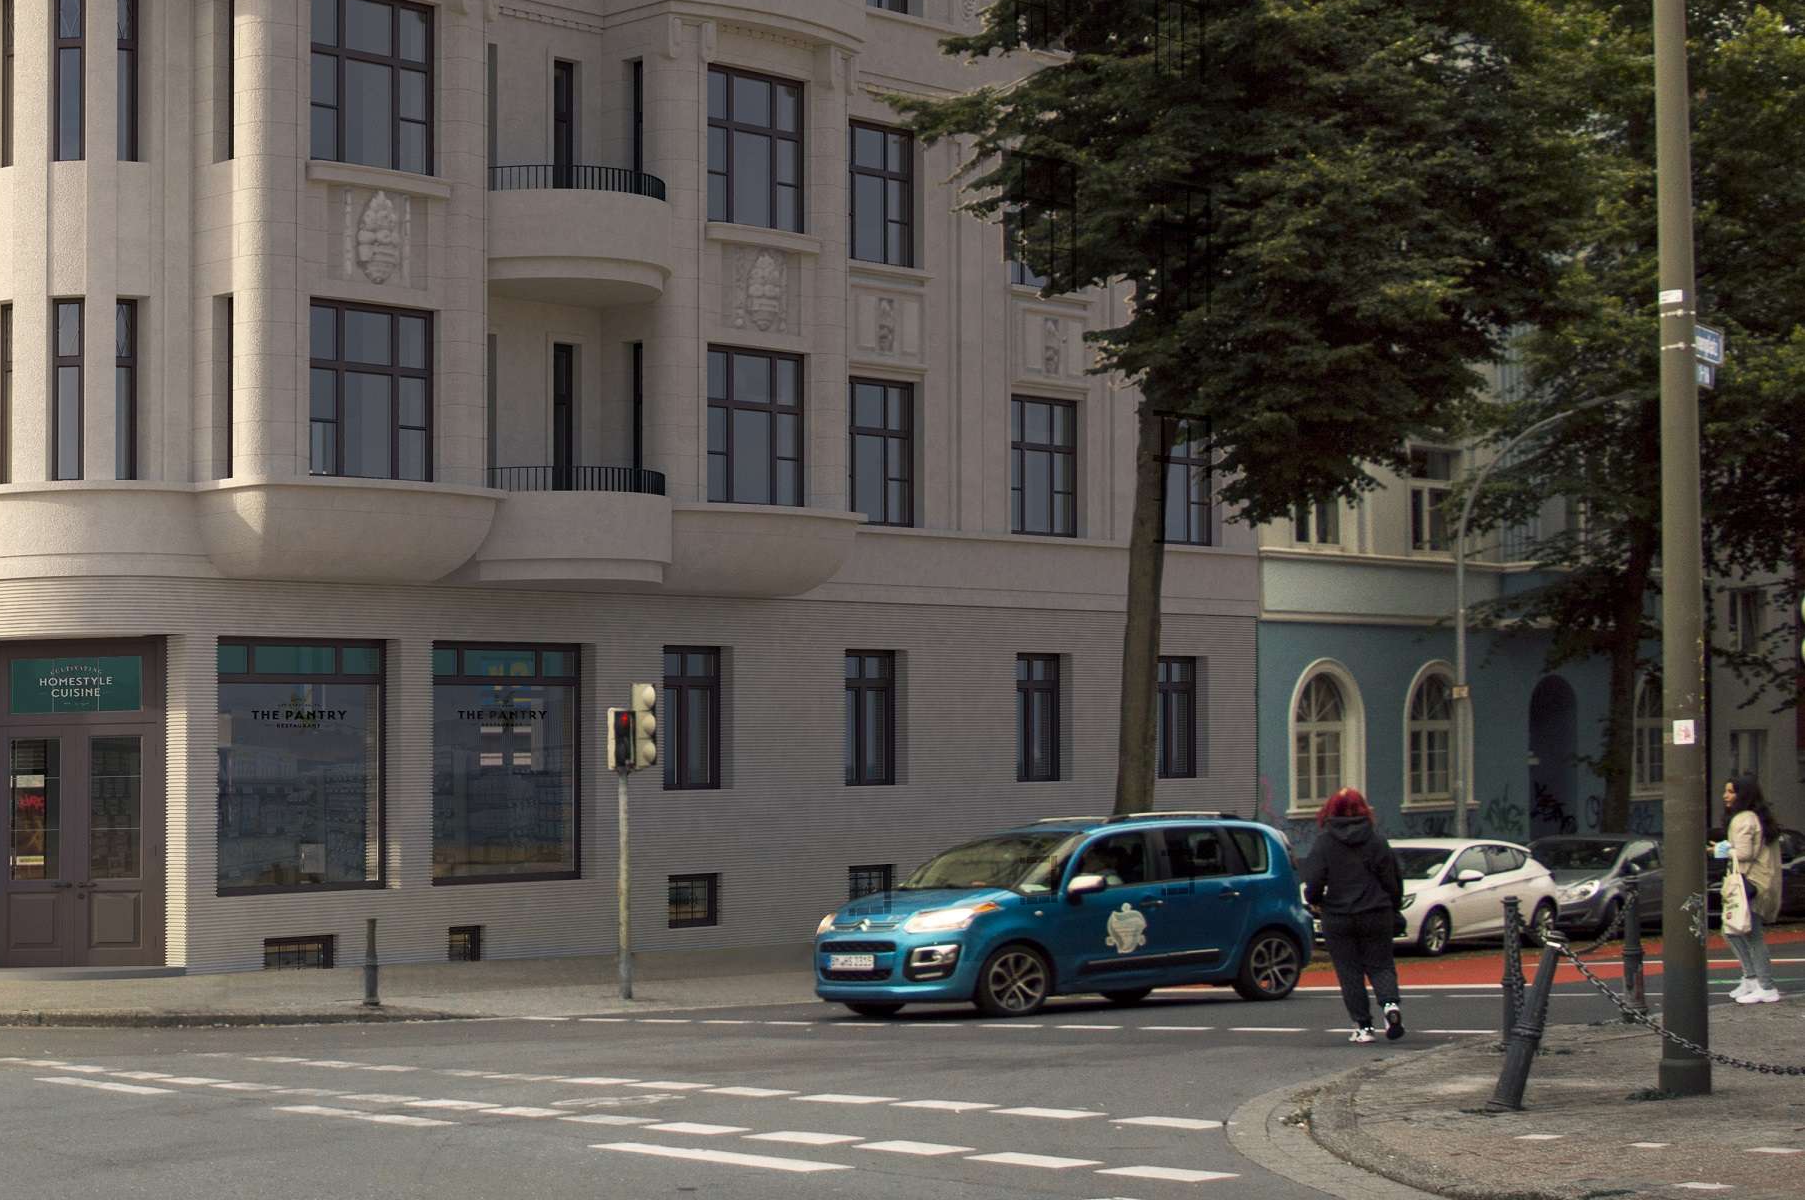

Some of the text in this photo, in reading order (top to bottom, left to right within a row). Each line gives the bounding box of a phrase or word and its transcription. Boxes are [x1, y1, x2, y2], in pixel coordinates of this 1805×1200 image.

[39, 676, 113, 687] HOMESTYLE
[51, 688, 101, 698] CUISINE
[251, 710, 347, 721] THE PANTRY
[457, 710, 548, 720] THE PANTRY
